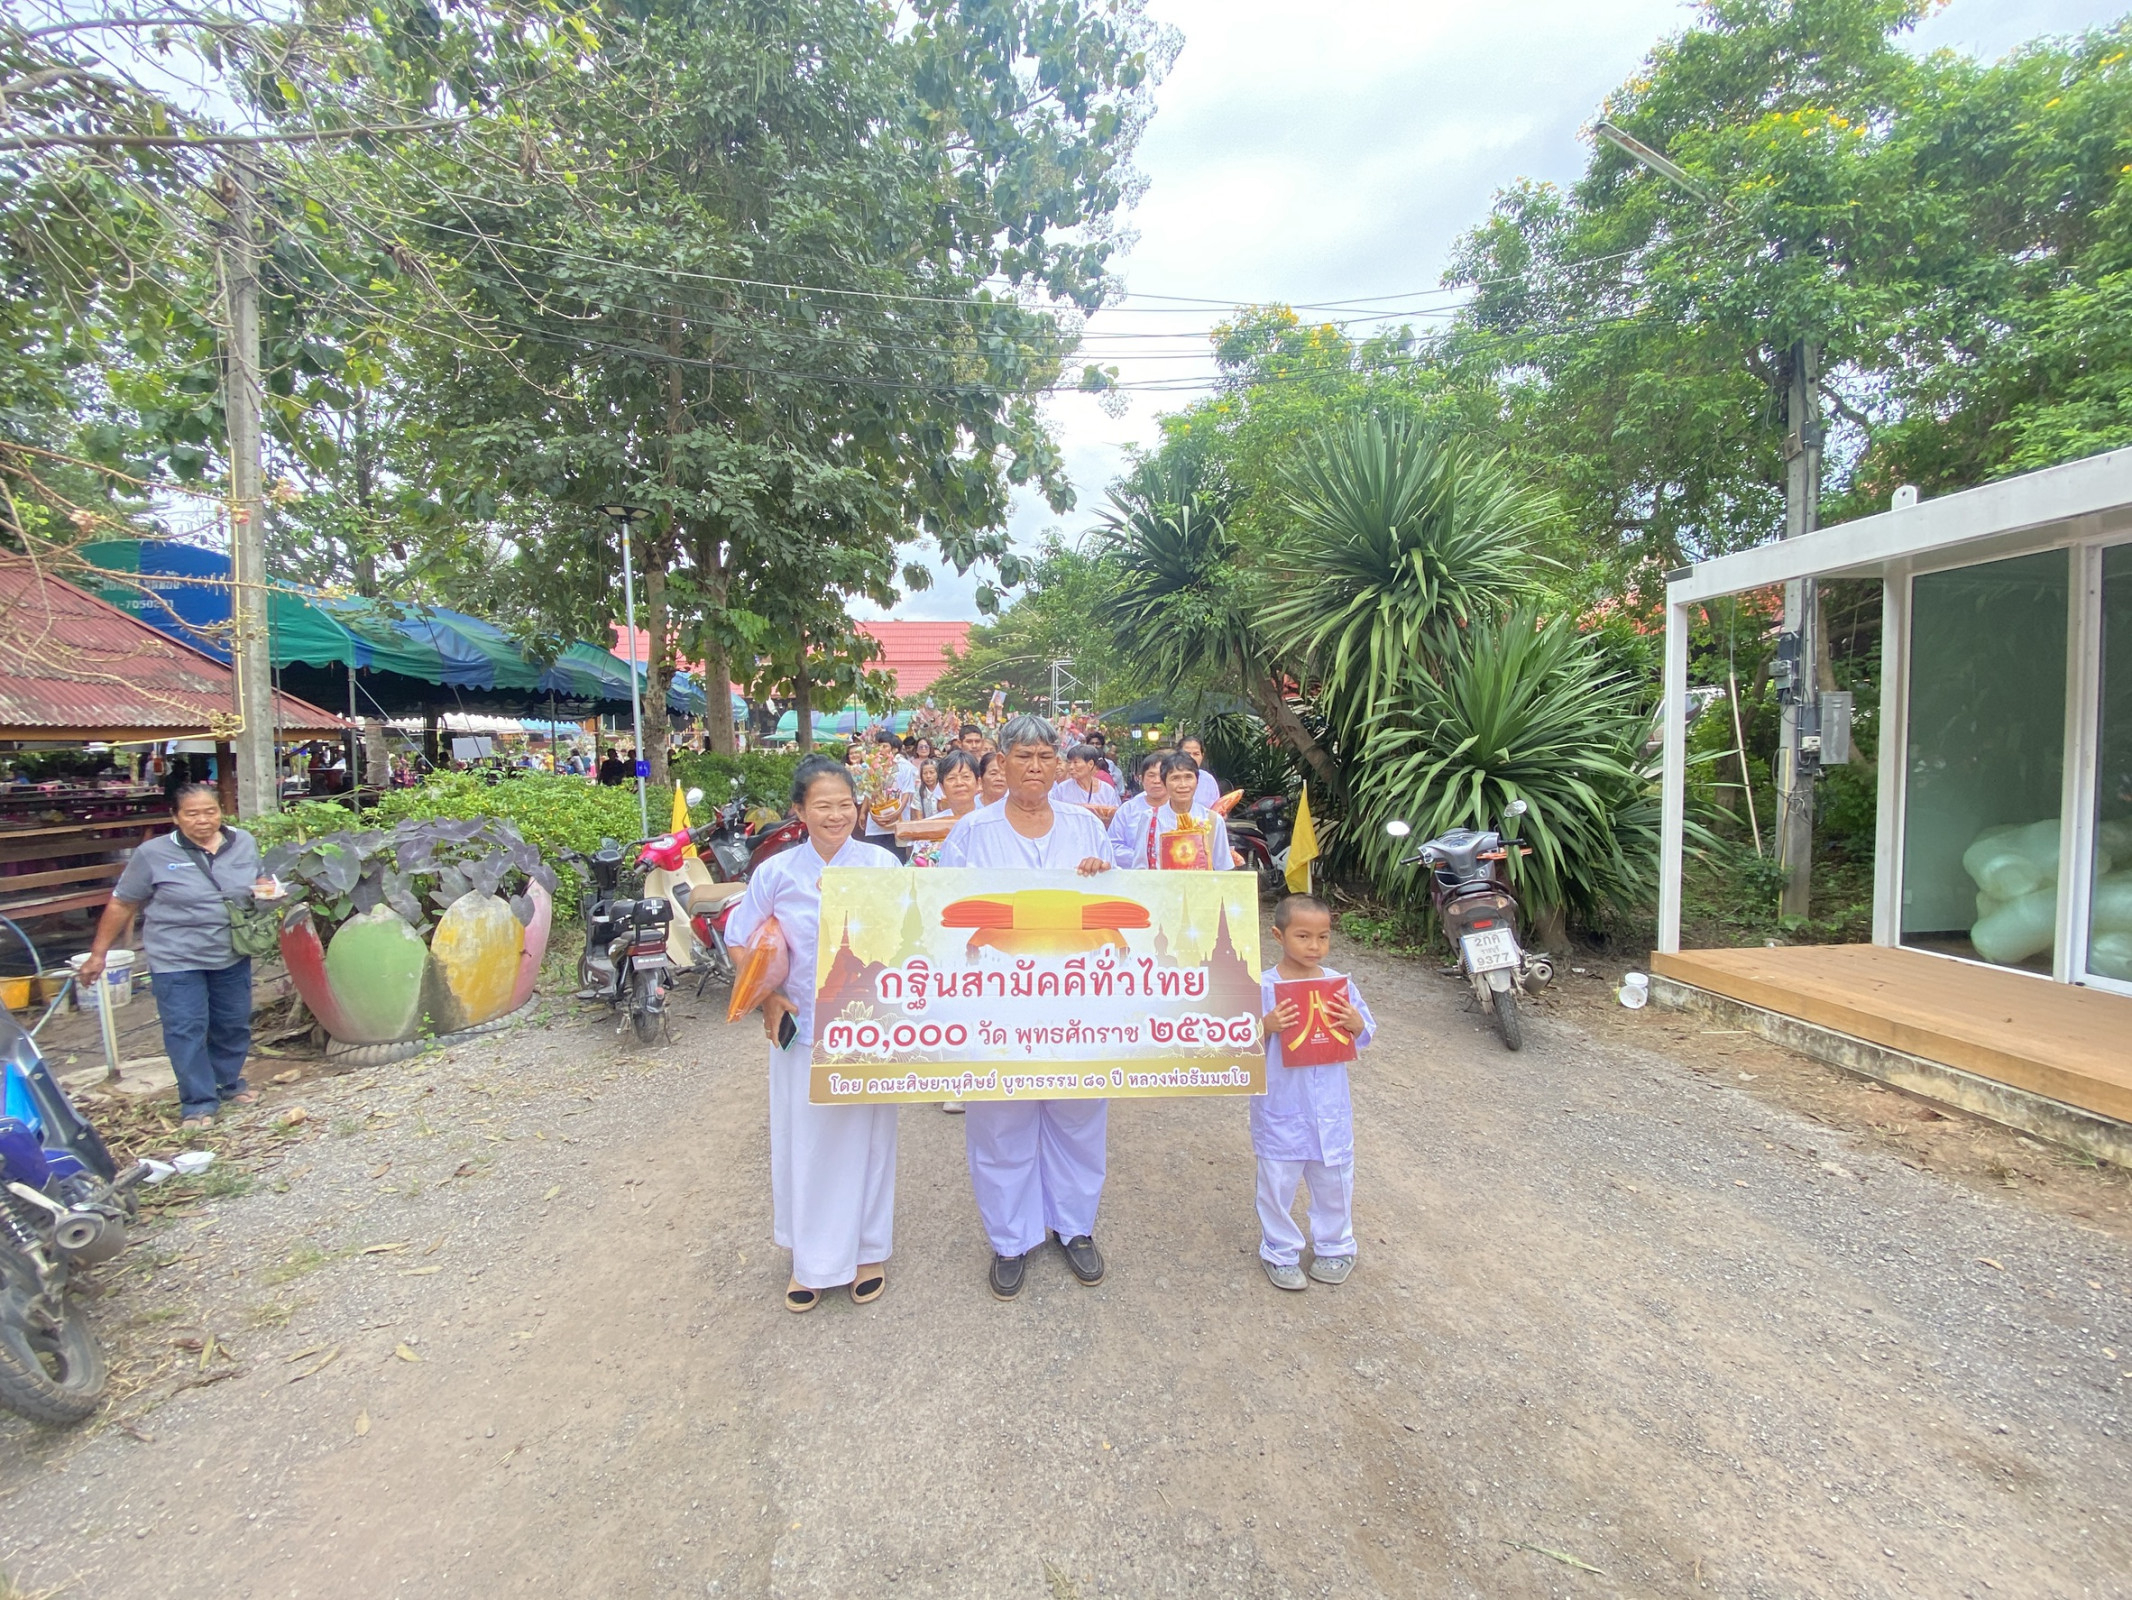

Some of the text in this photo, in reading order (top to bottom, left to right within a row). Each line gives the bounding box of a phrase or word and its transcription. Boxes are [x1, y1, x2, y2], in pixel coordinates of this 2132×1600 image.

[1477, 952, 1509, 966] 9377
[880, 948, 1205, 1010] กฐินสามัคคีทั่วไทย
[828, 1017, 1252, 1054] ๓๐,๐๐๐ วัด พุทธศักราช ๒๕๖๘
[831, 1068, 1249, 1095] โดย คณะศิษยานุศิษย์ บูชาธรรม ๘๑ ปี หลวงพ่อธัมมชโย
